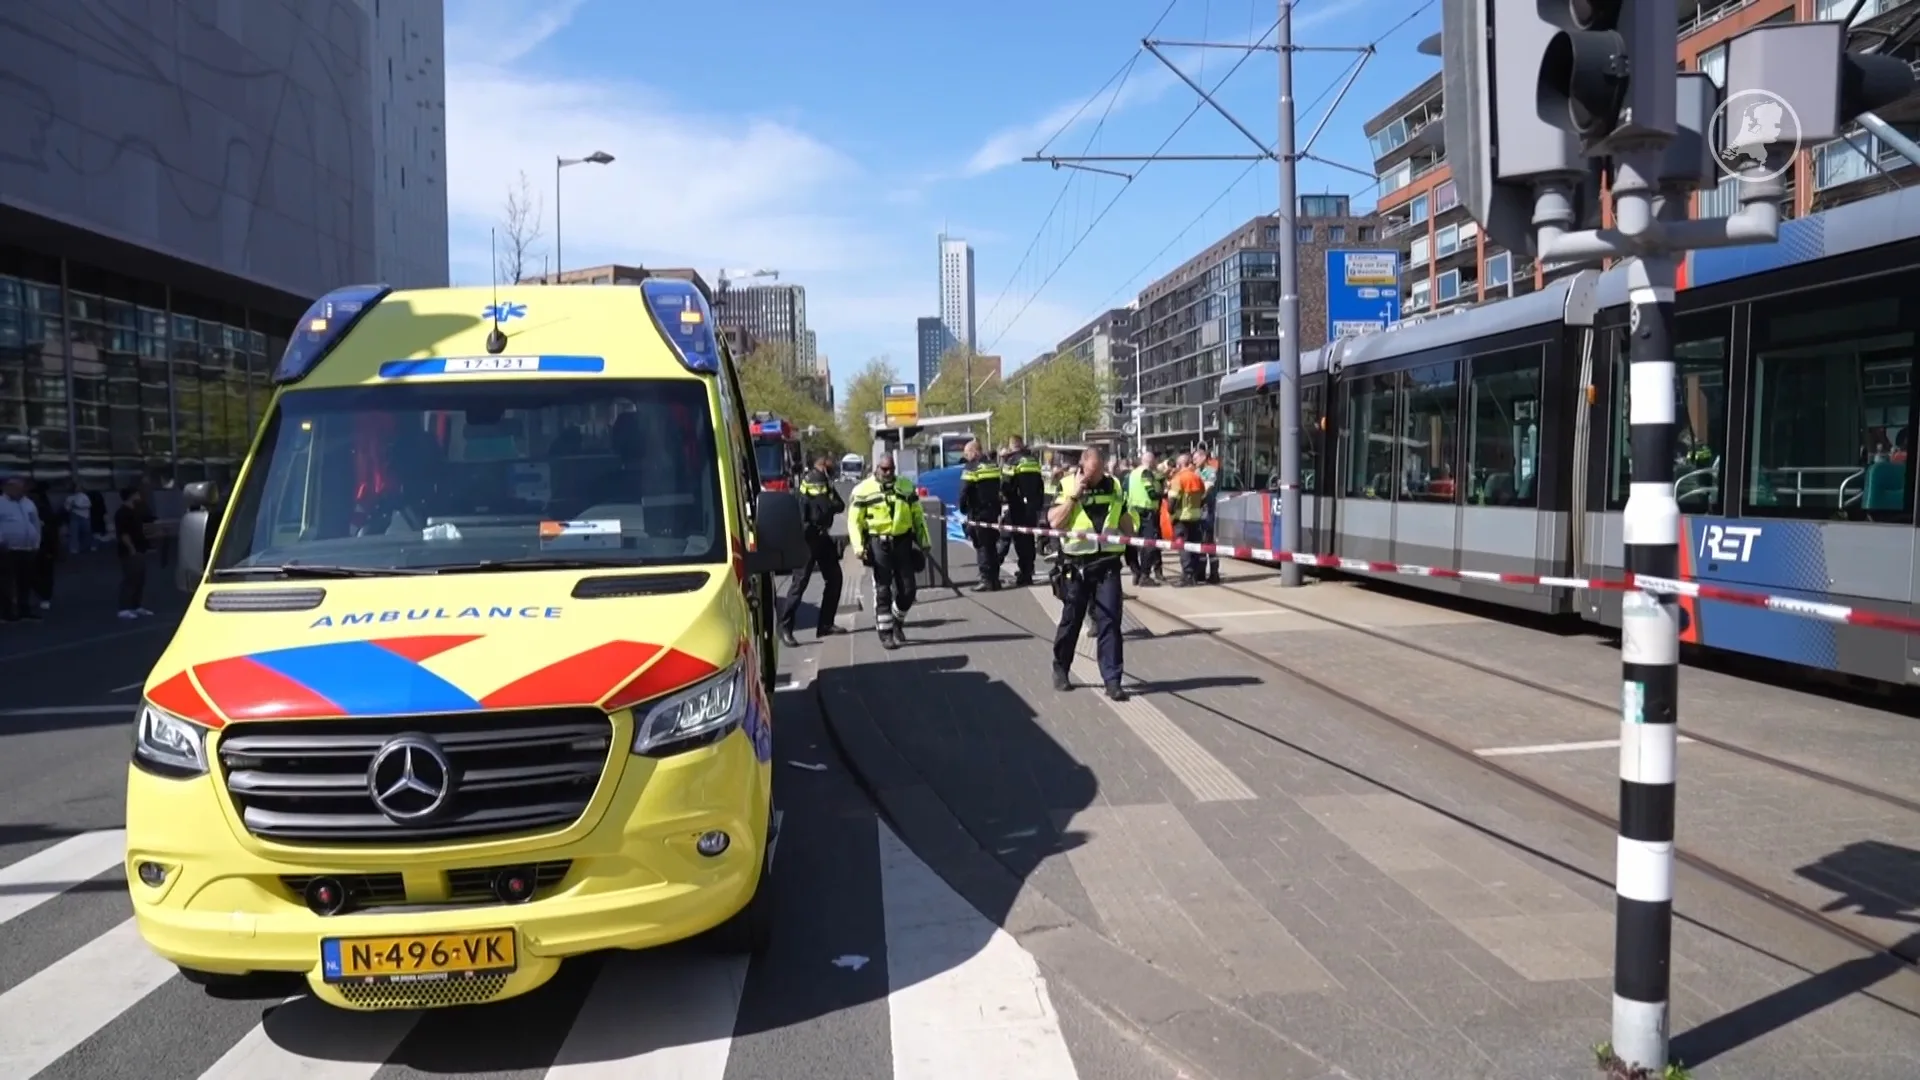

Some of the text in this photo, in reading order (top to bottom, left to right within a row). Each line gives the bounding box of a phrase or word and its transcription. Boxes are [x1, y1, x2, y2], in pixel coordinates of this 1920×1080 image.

[463, 356, 524, 369] 17-121
[1699, 524, 1762, 562] RET
[308, 606, 563, 630] AMBULANCE
[351, 936, 505, 970] N-496-VK
[326, 961, 340, 971] NL
